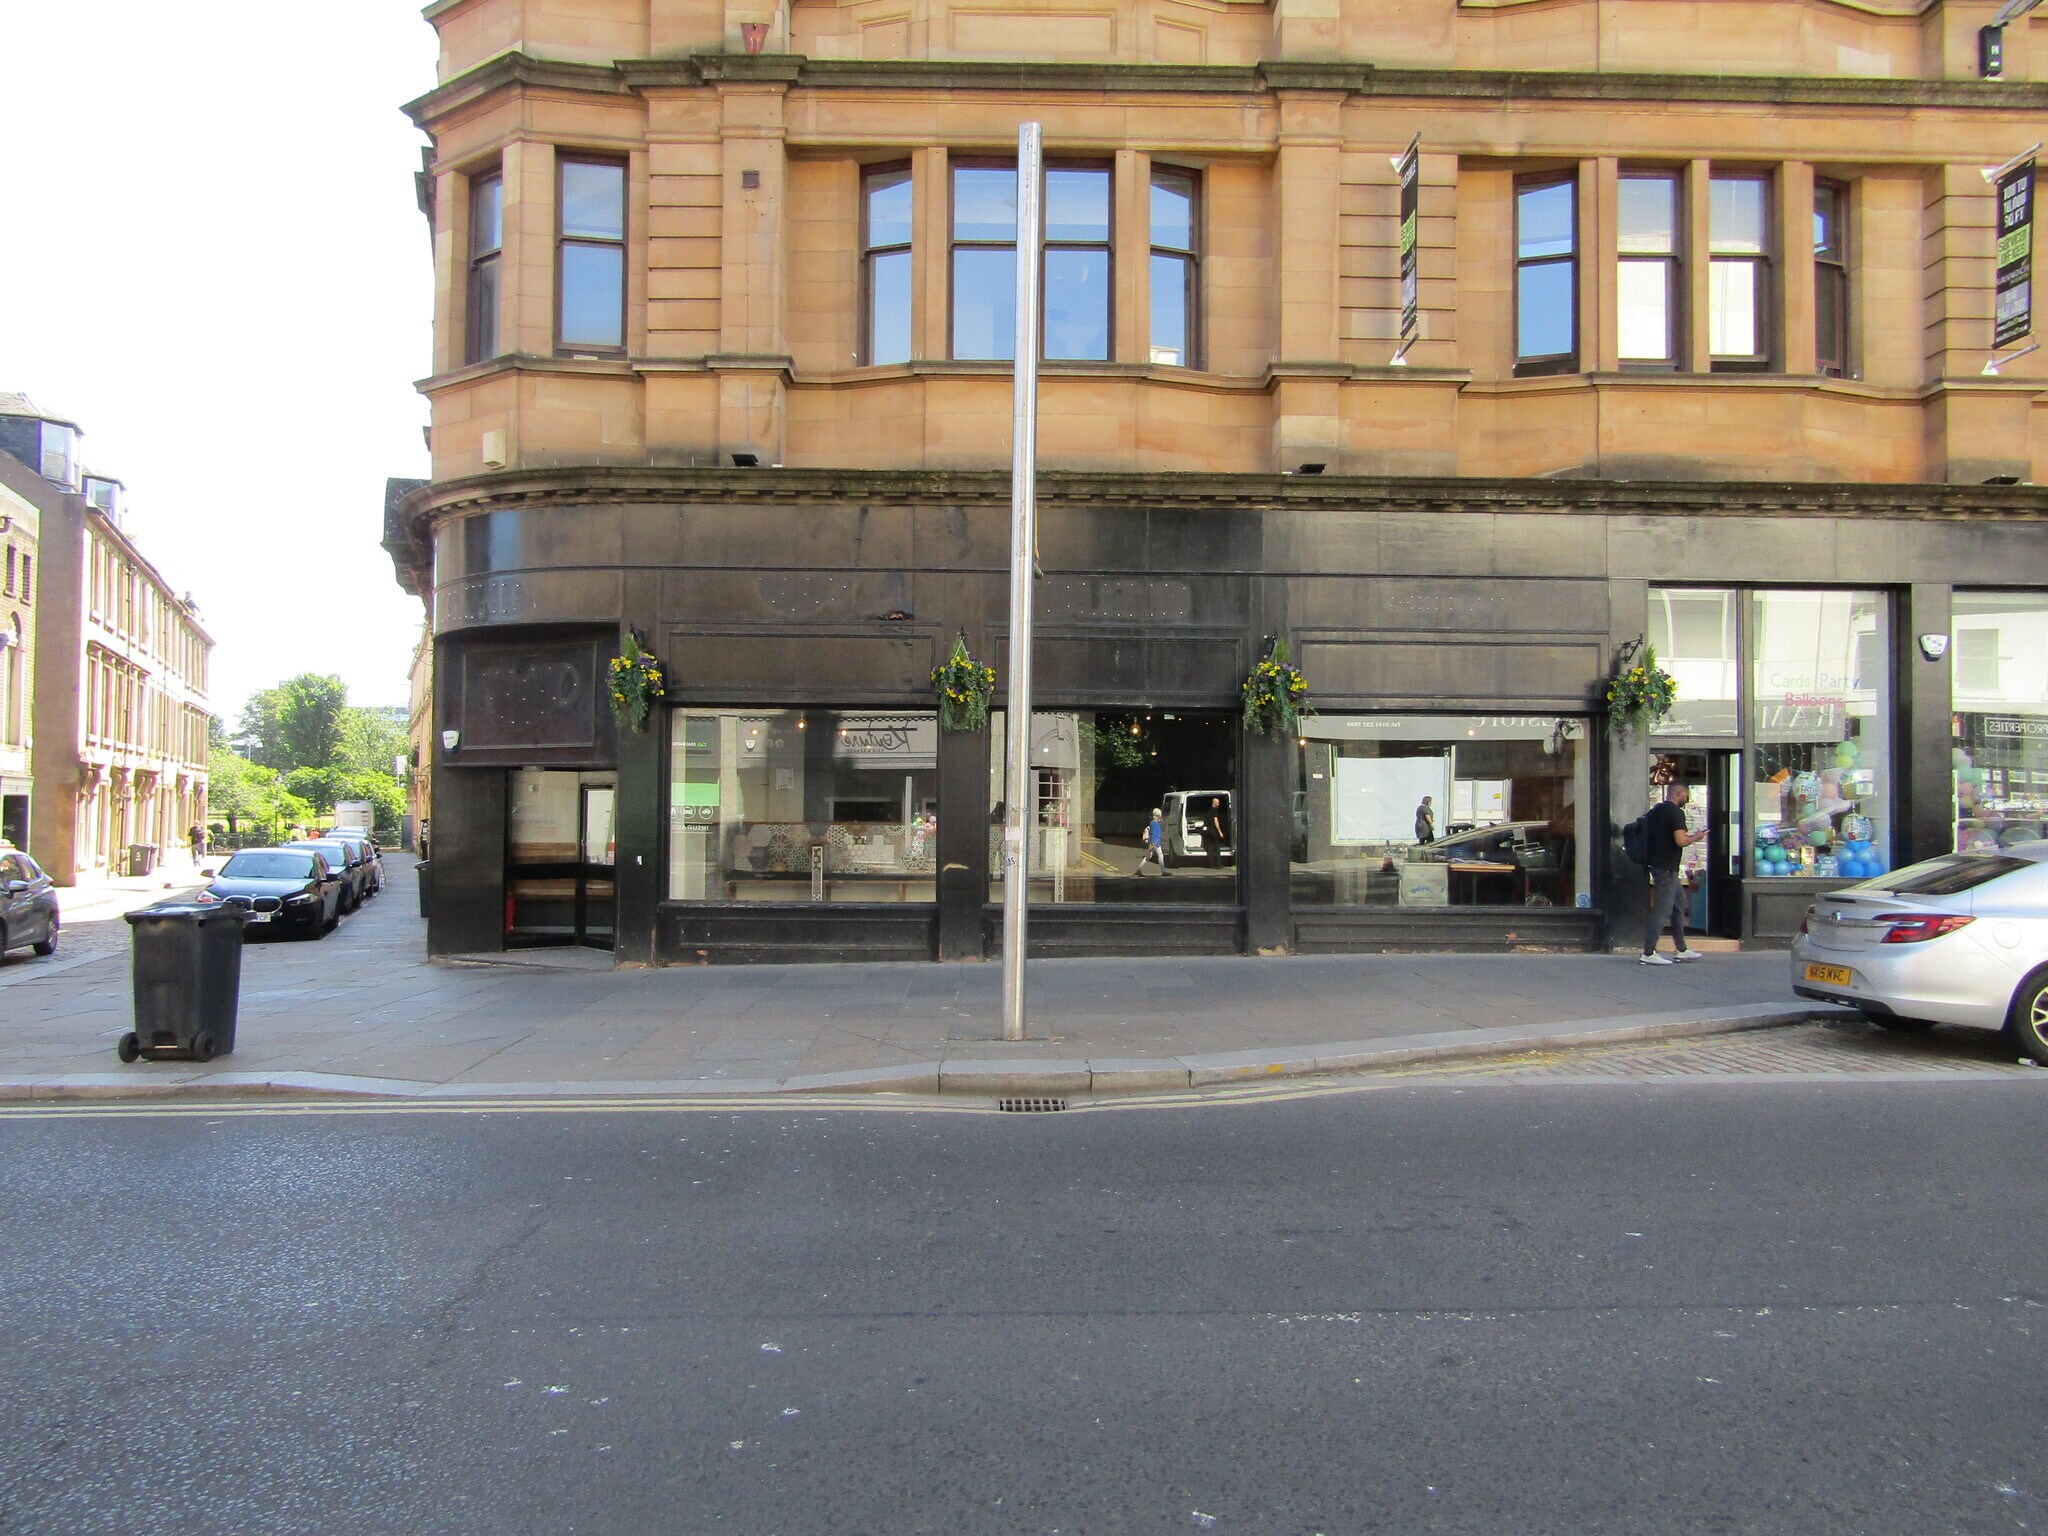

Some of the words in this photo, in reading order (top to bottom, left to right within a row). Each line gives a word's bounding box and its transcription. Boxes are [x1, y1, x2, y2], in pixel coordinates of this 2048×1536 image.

[1770, 673, 1811, 687] Cards
[1819, 673, 1860, 691] Party
[1785, 692, 1844, 707] Balloons
